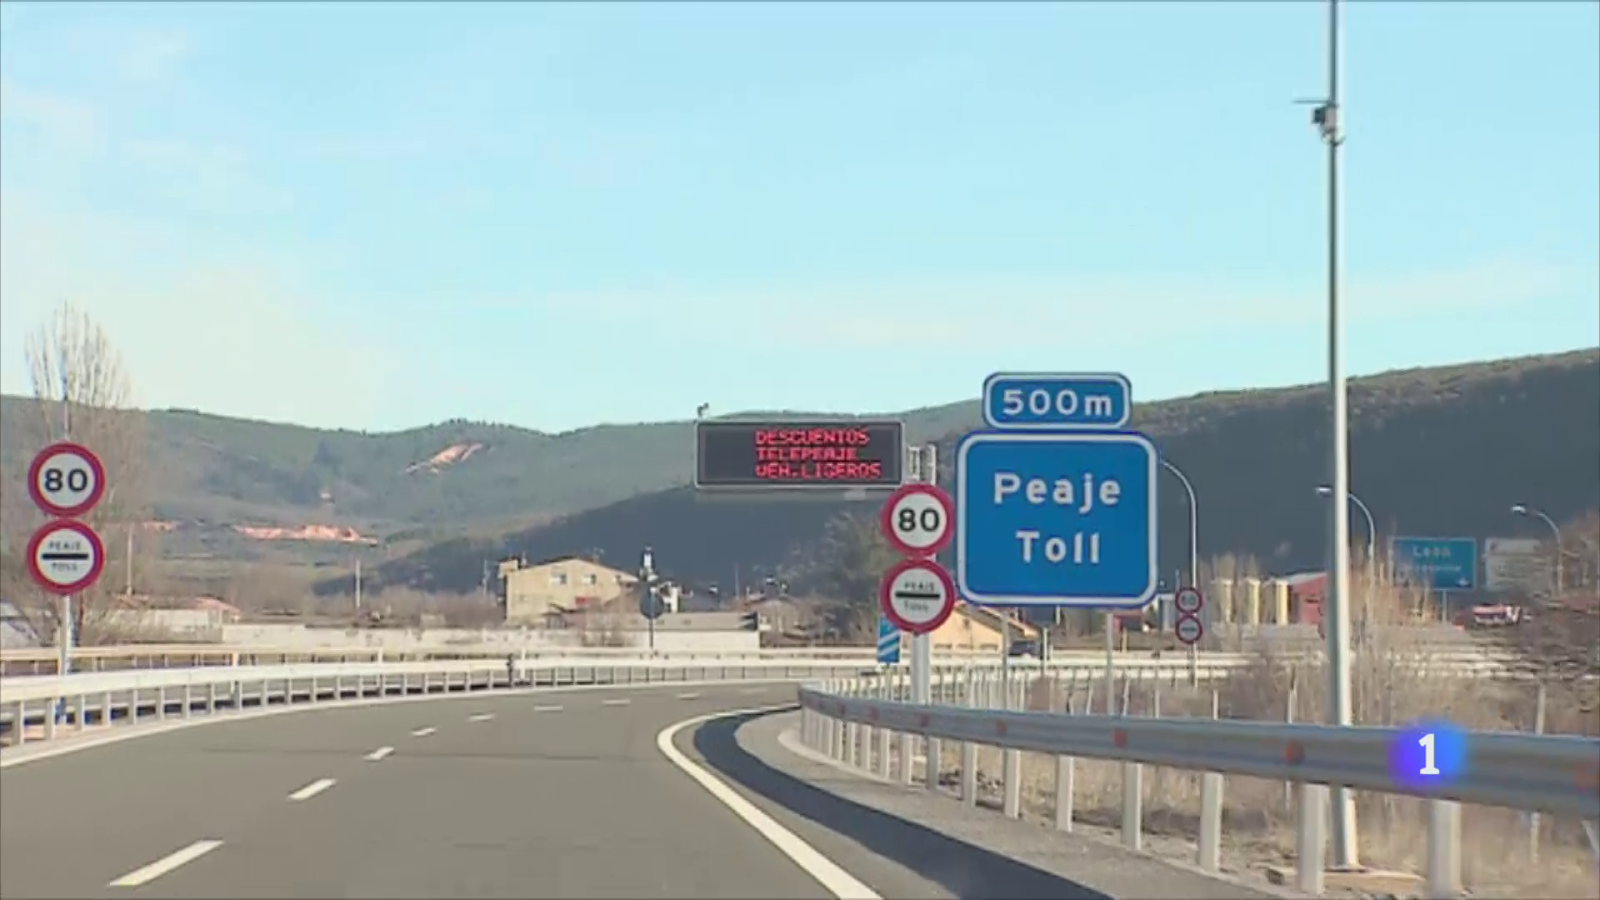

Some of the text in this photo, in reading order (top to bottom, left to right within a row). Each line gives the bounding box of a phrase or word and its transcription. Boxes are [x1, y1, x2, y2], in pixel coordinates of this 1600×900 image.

[1002, 389, 1112, 416] 500m
[756, 430, 870, 445] DESCUENTOS
[757, 447, 857, 461] TELEPEAJE
[45, 468, 88, 492] 80
[993, 472, 1121, 514] Peaje
[898, 507, 940, 532] 80
[1015, 530, 1100, 564] Toll
